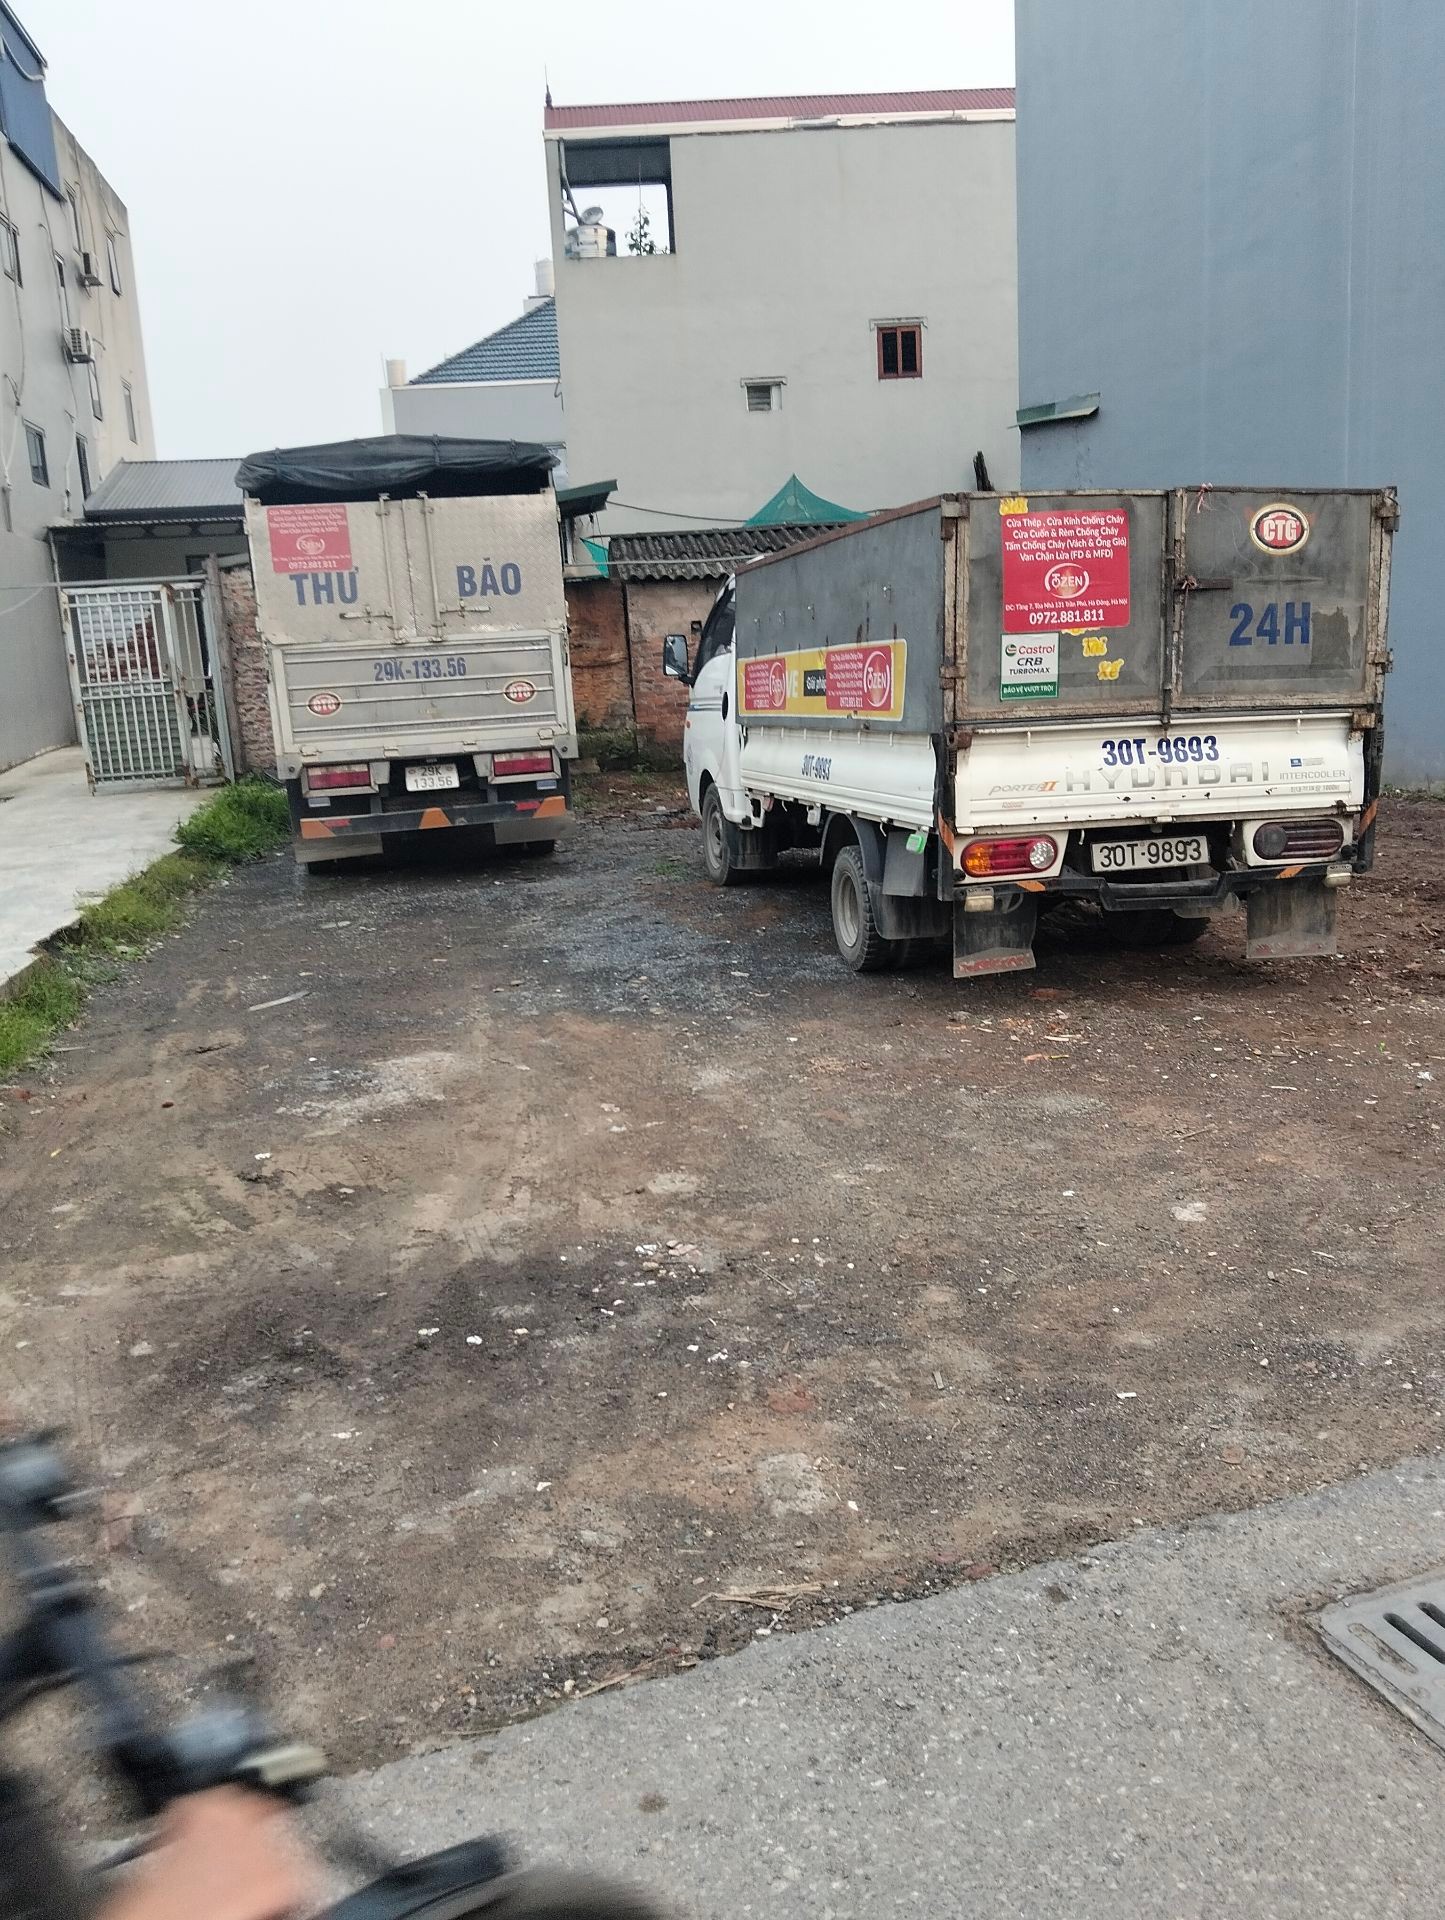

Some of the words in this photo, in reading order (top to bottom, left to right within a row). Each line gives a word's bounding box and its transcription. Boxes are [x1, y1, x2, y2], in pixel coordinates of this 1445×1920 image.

[1106, 514, 1125, 525] Cháy
[1050, 529, 1058, 538] &
[1100, 526, 1119, 537] Cháy
[1263, 519, 1298, 541] CTG
[1047, 538, 1066, 550] Cháy
[1088, 538, 1095, 547] &
[1019, 550, 1035, 562] Van
[1070, 548, 1084, 560] (FD
[1085, 549, 1092, 559] &
[1092, 547, 1114, 559] MFD)
[1029, 608, 1105, 625] 0972.881.811
[1229, 602, 1312, 647] 24H
[1018, 644, 1056, 656] Castrol
[1016, 656, 1043, 667] CRB
[373, 657, 467, 682] 29K-133.56
[1009, 667, 1050, 676] TURBOMAX
[1101, 735, 1220, 767] 30T-9893
[420, 766, 442, 777] 29K
[1064, 760, 1269, 792] HYUNDAI
[1279, 769, 1346, 781] INTERCOOLER
[414, 776, 453, 789] 133.56
[1099, 838, 1202, 868] 30T-9893
